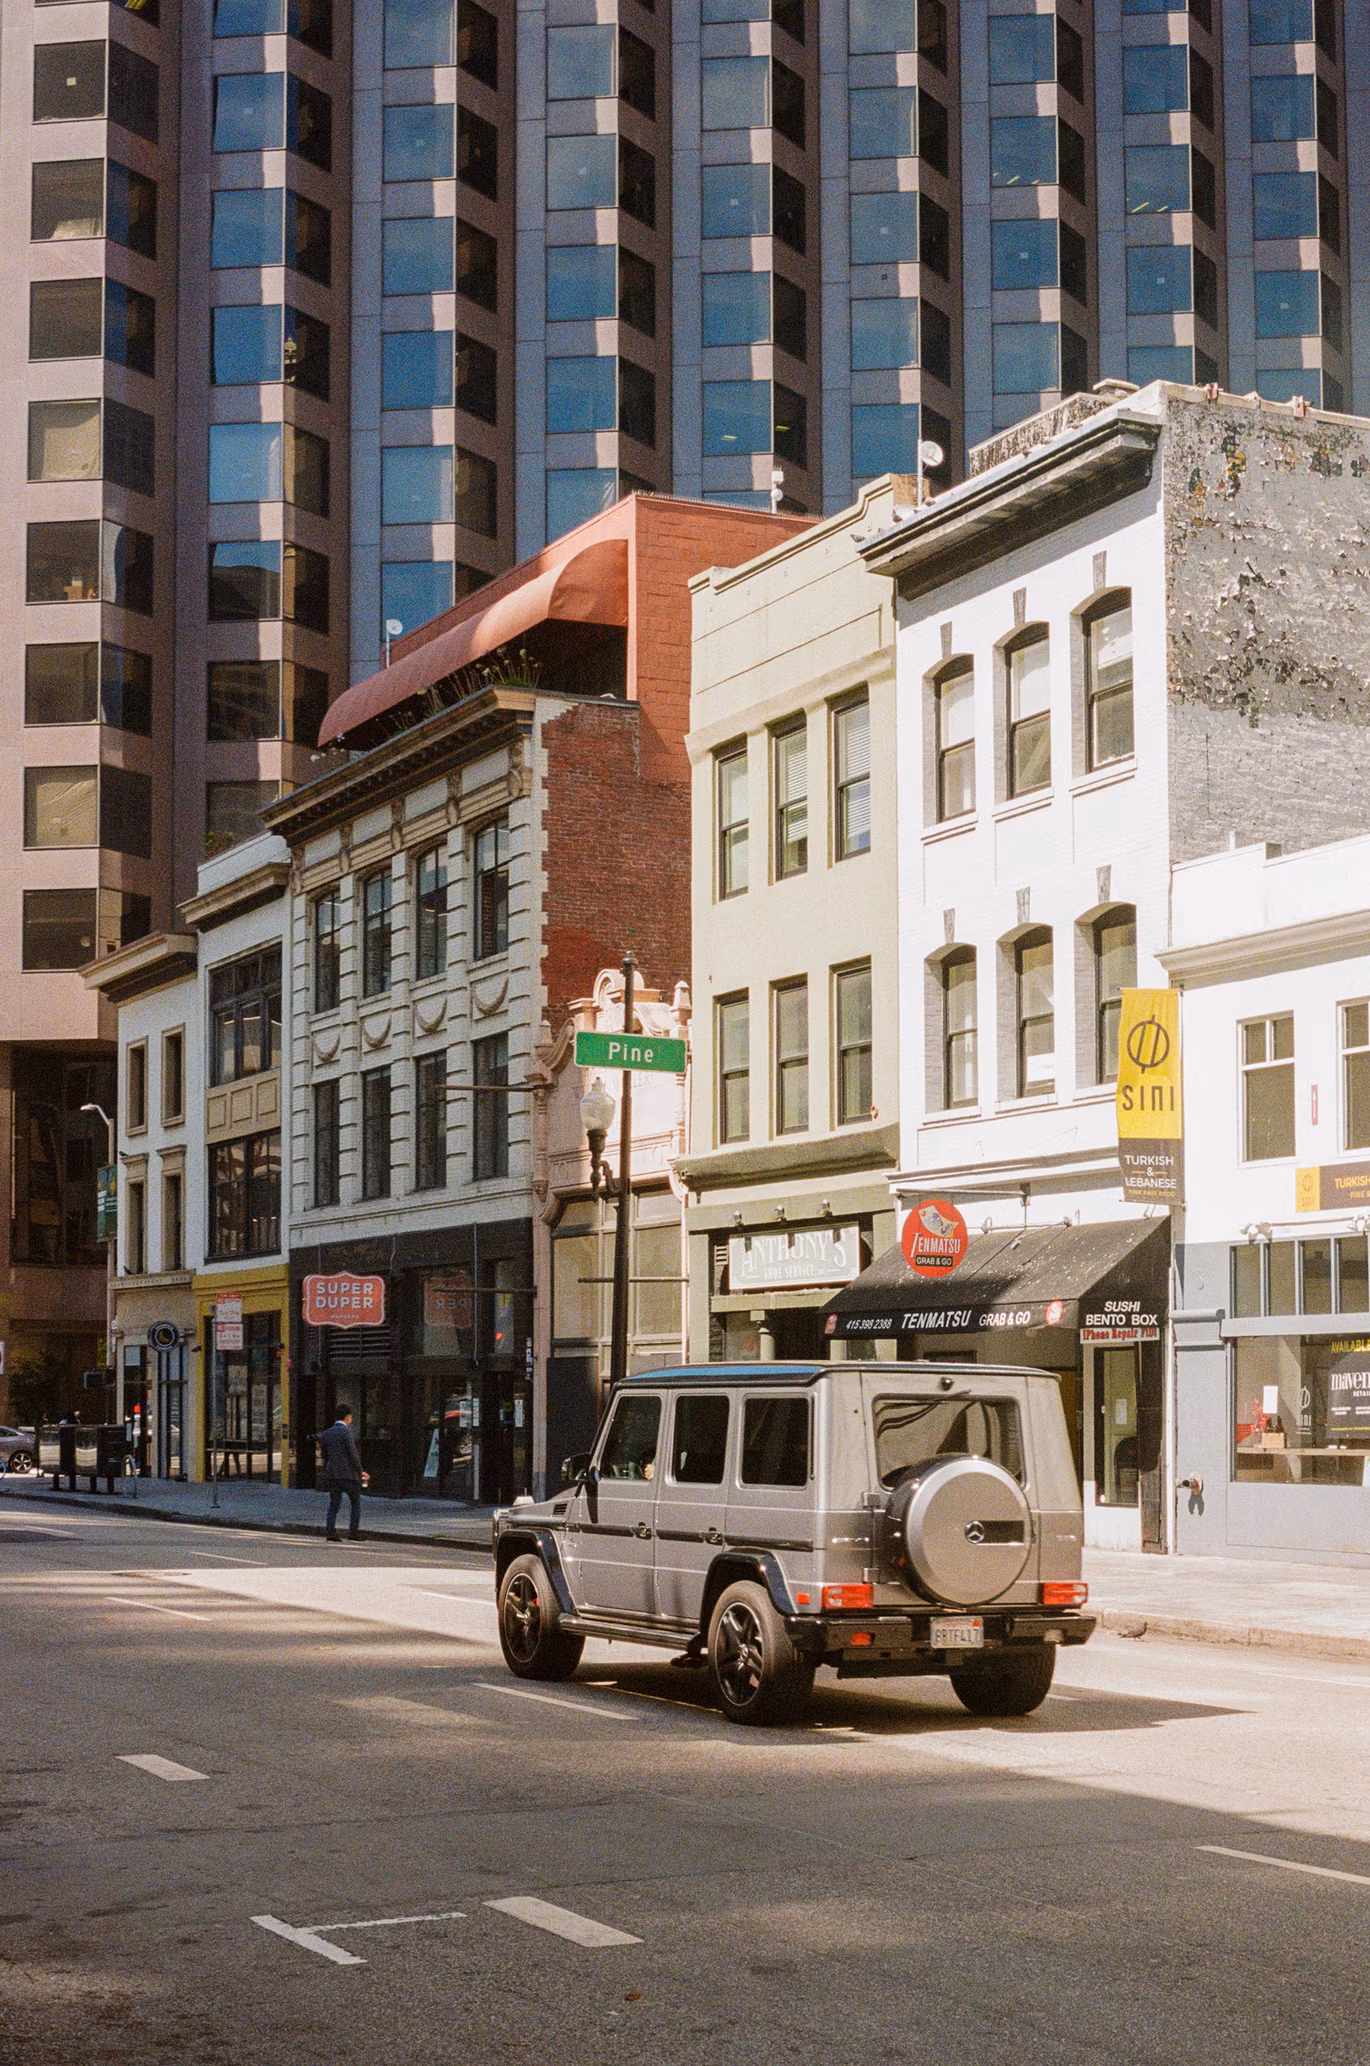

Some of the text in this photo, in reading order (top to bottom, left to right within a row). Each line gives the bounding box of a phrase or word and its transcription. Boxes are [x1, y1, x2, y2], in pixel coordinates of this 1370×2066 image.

[608, 1041, 654, 1063] Pine
[1124, 1155, 1174, 1166] TURKISH
[1146, 1167, 1154, 1177] &
[1125, 1177, 1177, 1188] LEBANESE
[910, 1232, 961, 1258] TENMATSU
[916, 1256, 935, 1265] GRAB
[936, 1257, 941, 1265] &
[315, 1282, 373, 1294] SUPER
[315, 1296, 373, 1308] DUPER
[1104, 1301, 1141, 1312] SUSHI
[901, 1310, 972, 1329] TENMATSU
[1085, 1314, 1158, 1326] BENTO BOX
[1083, 1328, 1110, 1340] iPhone
[1111, 1327, 1138, 1340] Repair
